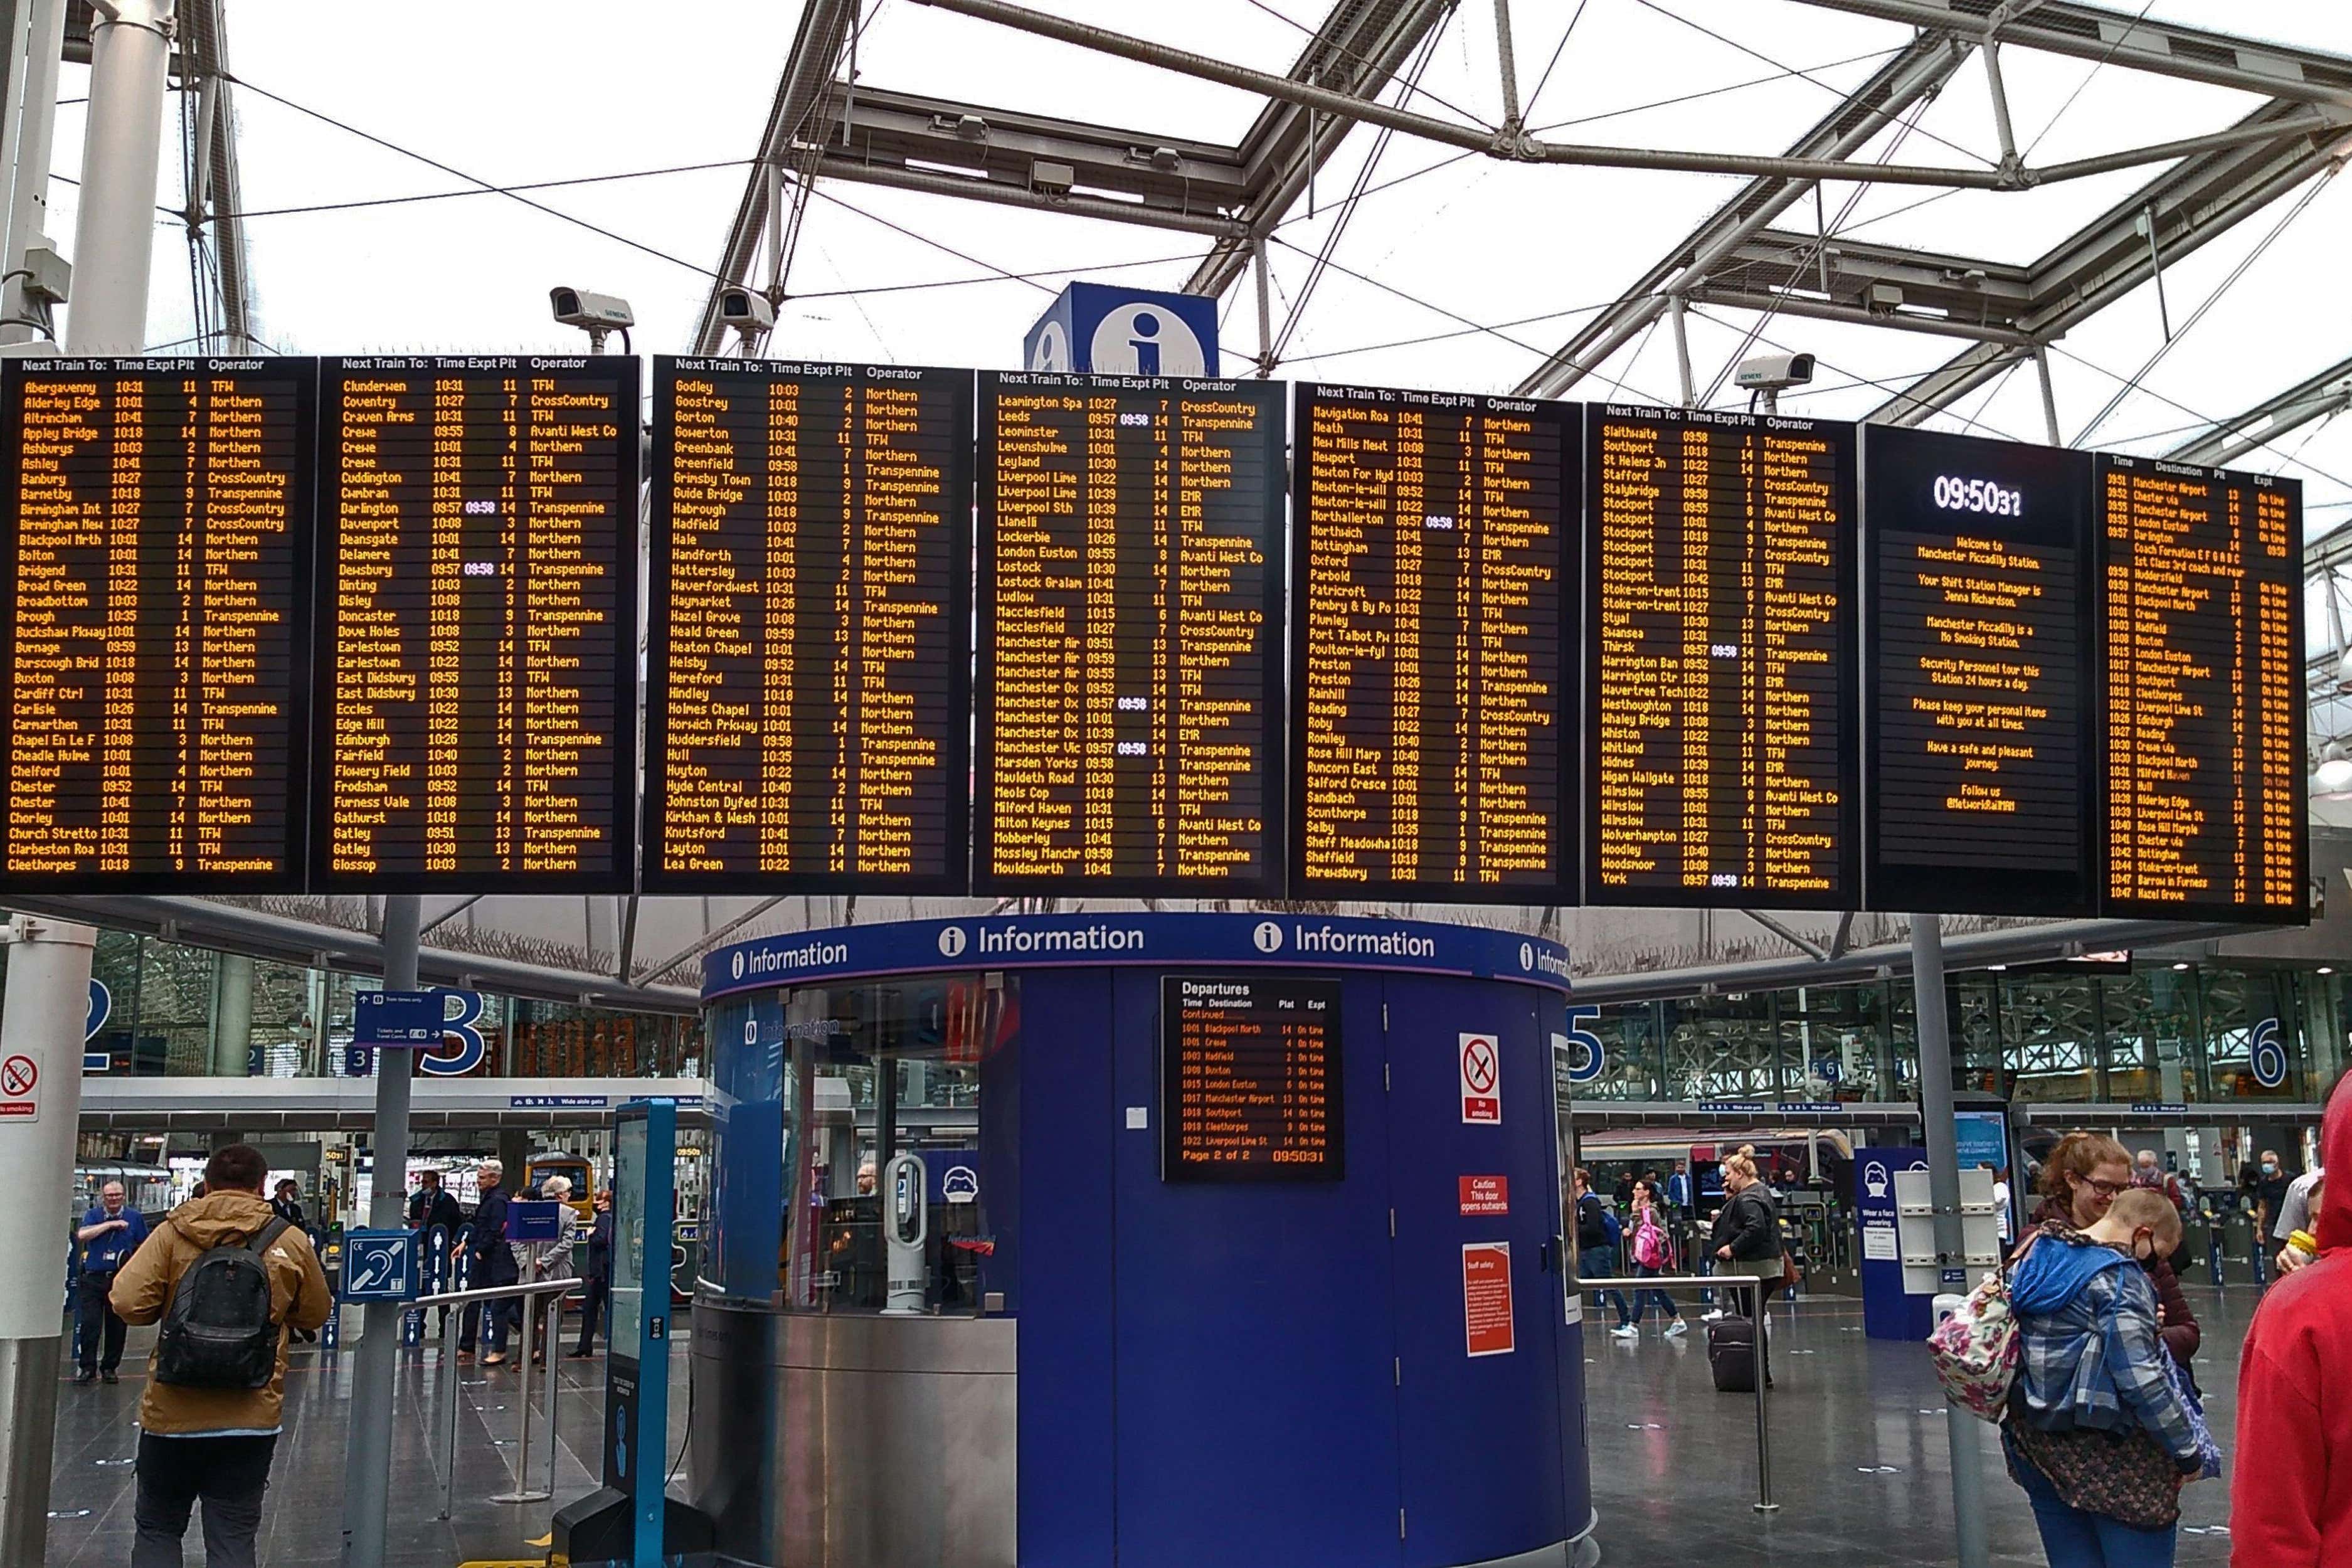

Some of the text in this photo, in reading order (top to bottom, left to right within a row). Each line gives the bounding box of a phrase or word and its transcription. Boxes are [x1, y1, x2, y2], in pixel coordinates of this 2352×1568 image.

[23, 359, 265, 372] Next Train To: Time Expt Plt Operator
[342, 357, 587, 371] Next Train To: Time Expt Plt Operator
[675, 358, 923, 380] Next Train To: Time Expt Plt Operator
[25, 380, 234, 396] Abergavenny 10:31 11 TFW
[999, 372, 1237, 393] Next Train To: Time Expt Plt Operator
[1317, 386, 1537, 412] Next Train To: Time Expt Plt Operator
[1606, 405, 1814, 430] Next Train To: Time Expt Plt Operator
[2112, 455, 2272, 487] Time Destination Plt Expt
[341, 501, 605, 517] Darlington 09:57 09:58 14 Transpennine
[1956, 536, 2003, 552] Welcome to
[997, 545, 1263, 563] London Euston 09:55 8 Avanti West Co
[1918, 546, 2040, 569] Manchester Piccadilly Station.
[1311, 554, 1551, 580] Oxford 10:27 7 CrossCountry
[671, 579, 886, 597] Haverfordwest 10:31 11 TFW
[14, 687, 225, 699] Cardiff Ctrl 10:31 11 TFW
[1602, 697, 1809, 718] Westhoughton 10:18 14 Northern
[1913, 697, 2047, 718] Please keep your personal items
[667, 748, 935, 768] Hull 10:35 1 Transpennine
[1927, 741, 2033, 758] Have a safe and pleasant
[333, 857, 576, 873] Glossop 10:03 2 Northern
[1306, 865, 1500, 882] Shrewsbury 10:31 11 TFW
[980, 924, 1143, 952] Information
[1296, 924, 1434, 957] Information
[749, 941, 847, 974] Information
[1182, 982, 1249, 997] Departures
[1182, 998, 1325, 1010] Time Destination Plat Expt
[420, 987, 484, 1076] 3
[761, 1019, 839, 1041] Information
[1568, 1005, 1604, 1083] 5
[353, 1051, 365, 1066] 3
[2250, 1018, 2286, 1088] 6
[1826, 1062, 1834, 1074] 6
[1472, 1110, 1492, 1118] smoking
[1183, 1150, 1323, 1162] Page 2 of 2 09:50:31
[1473, 1179, 1495, 1189] Caution
[1471, 1191, 1498, 1200] This door
[1461, 1202, 1507, 1211] opens outwards
[354, 1242, 363, 1251] CE
